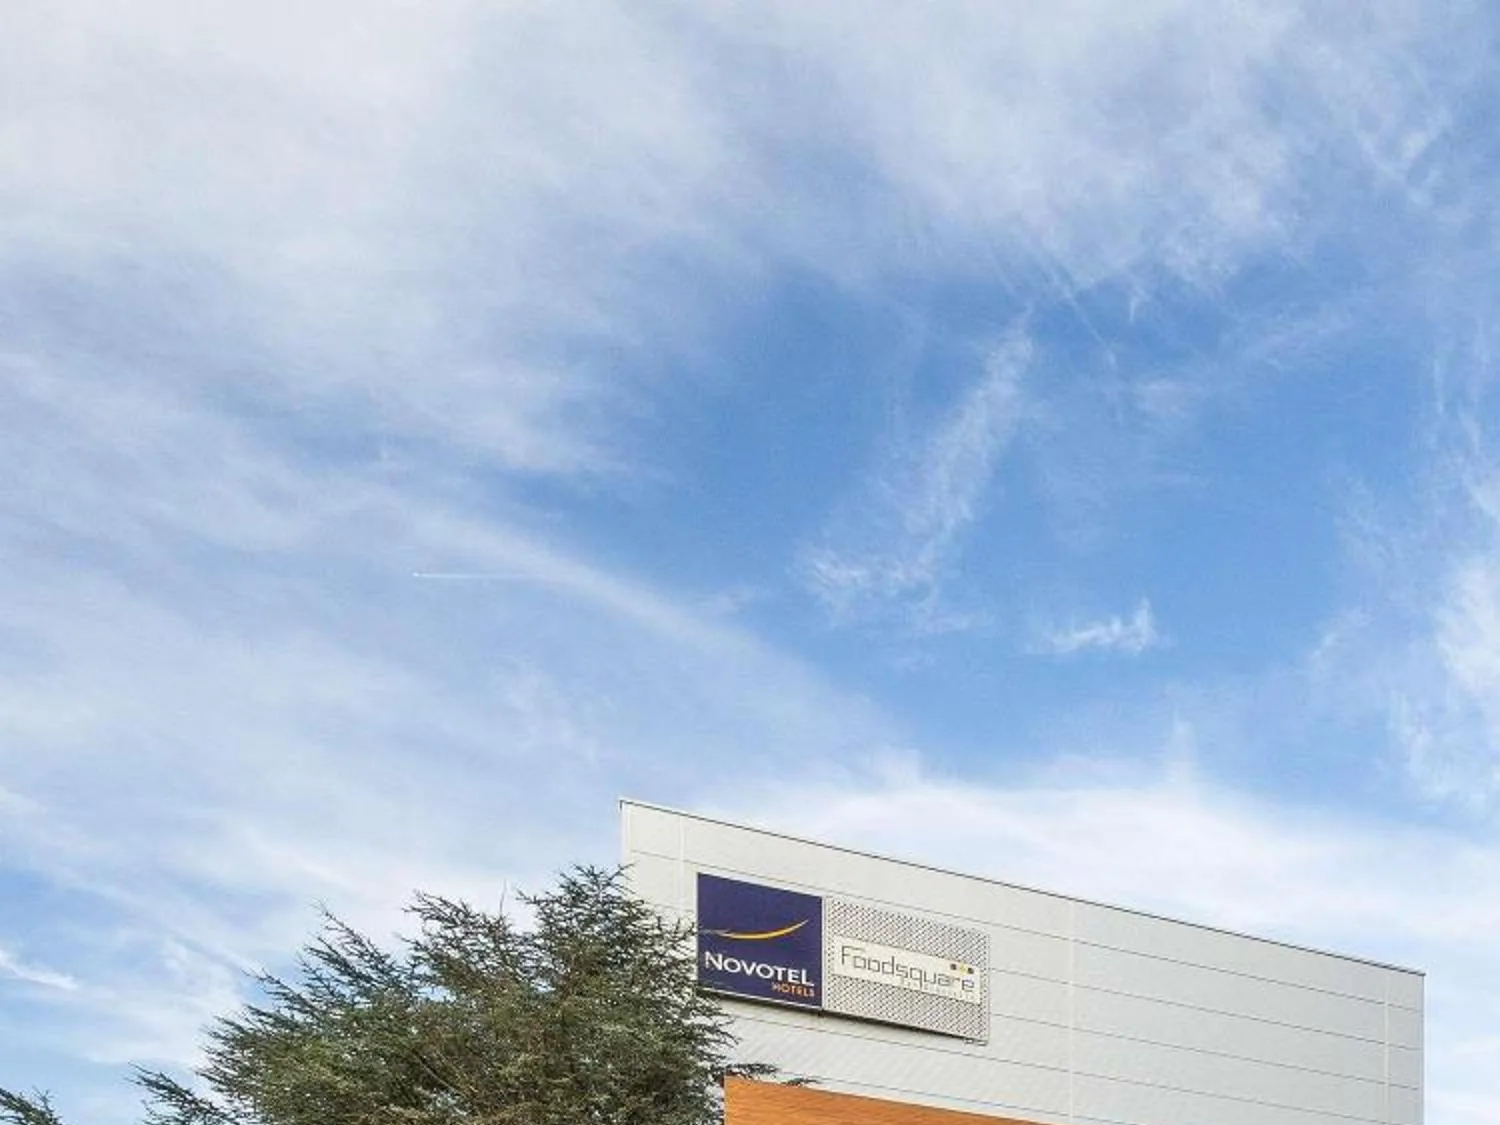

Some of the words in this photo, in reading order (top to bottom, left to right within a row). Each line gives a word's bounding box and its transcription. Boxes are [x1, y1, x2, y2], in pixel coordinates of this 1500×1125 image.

[704, 951, 815, 987] NOVOTEL
[841, 945, 976, 993] Foodsquare
[771, 982, 815, 998] HOTELS
